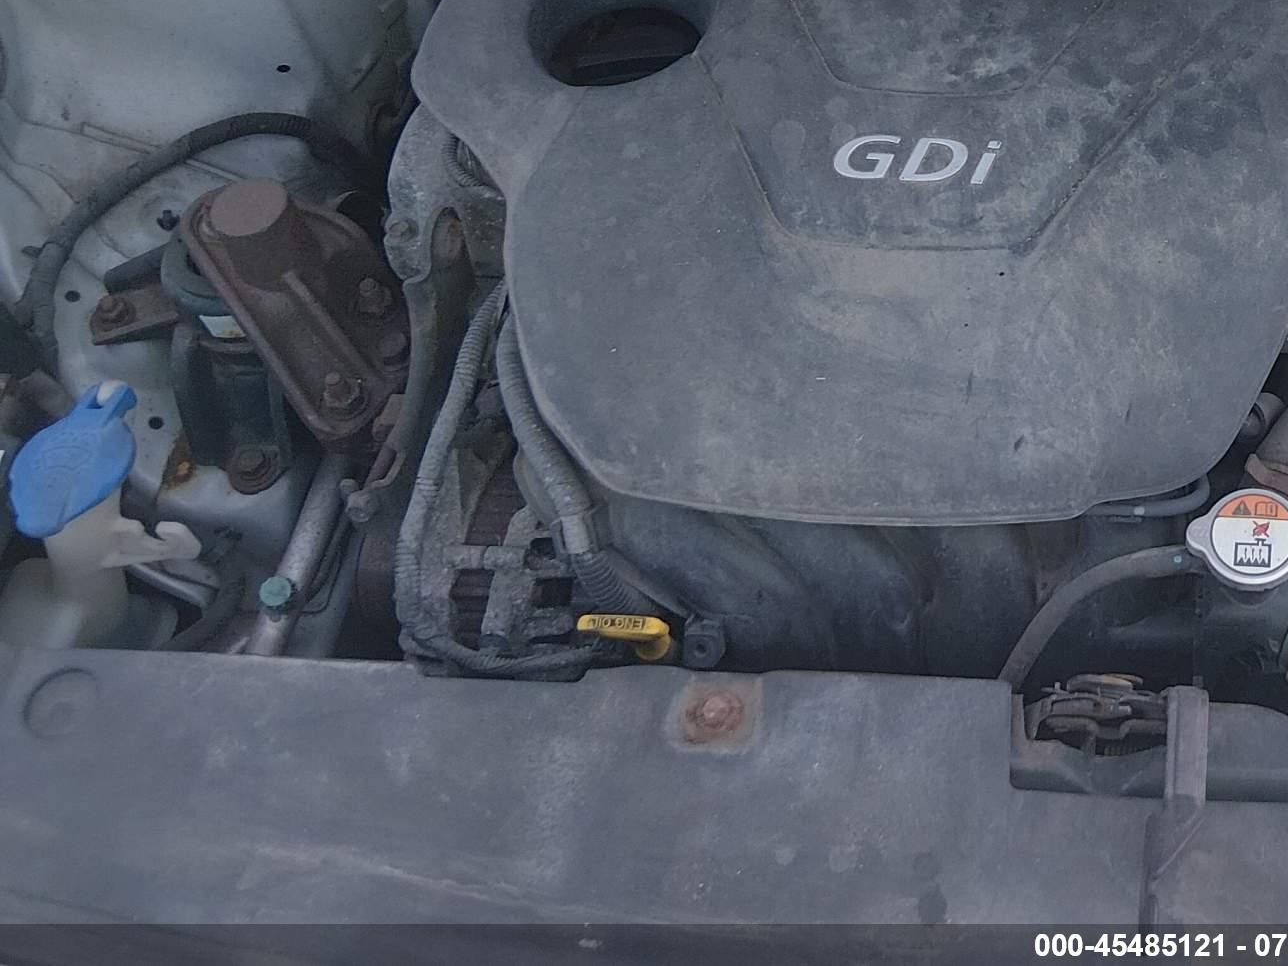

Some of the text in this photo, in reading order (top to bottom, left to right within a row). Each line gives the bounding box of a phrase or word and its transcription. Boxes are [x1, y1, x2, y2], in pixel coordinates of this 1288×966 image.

[833, 134, 1002, 184] GDi
[590, 617, 644, 630] ENG OIL
